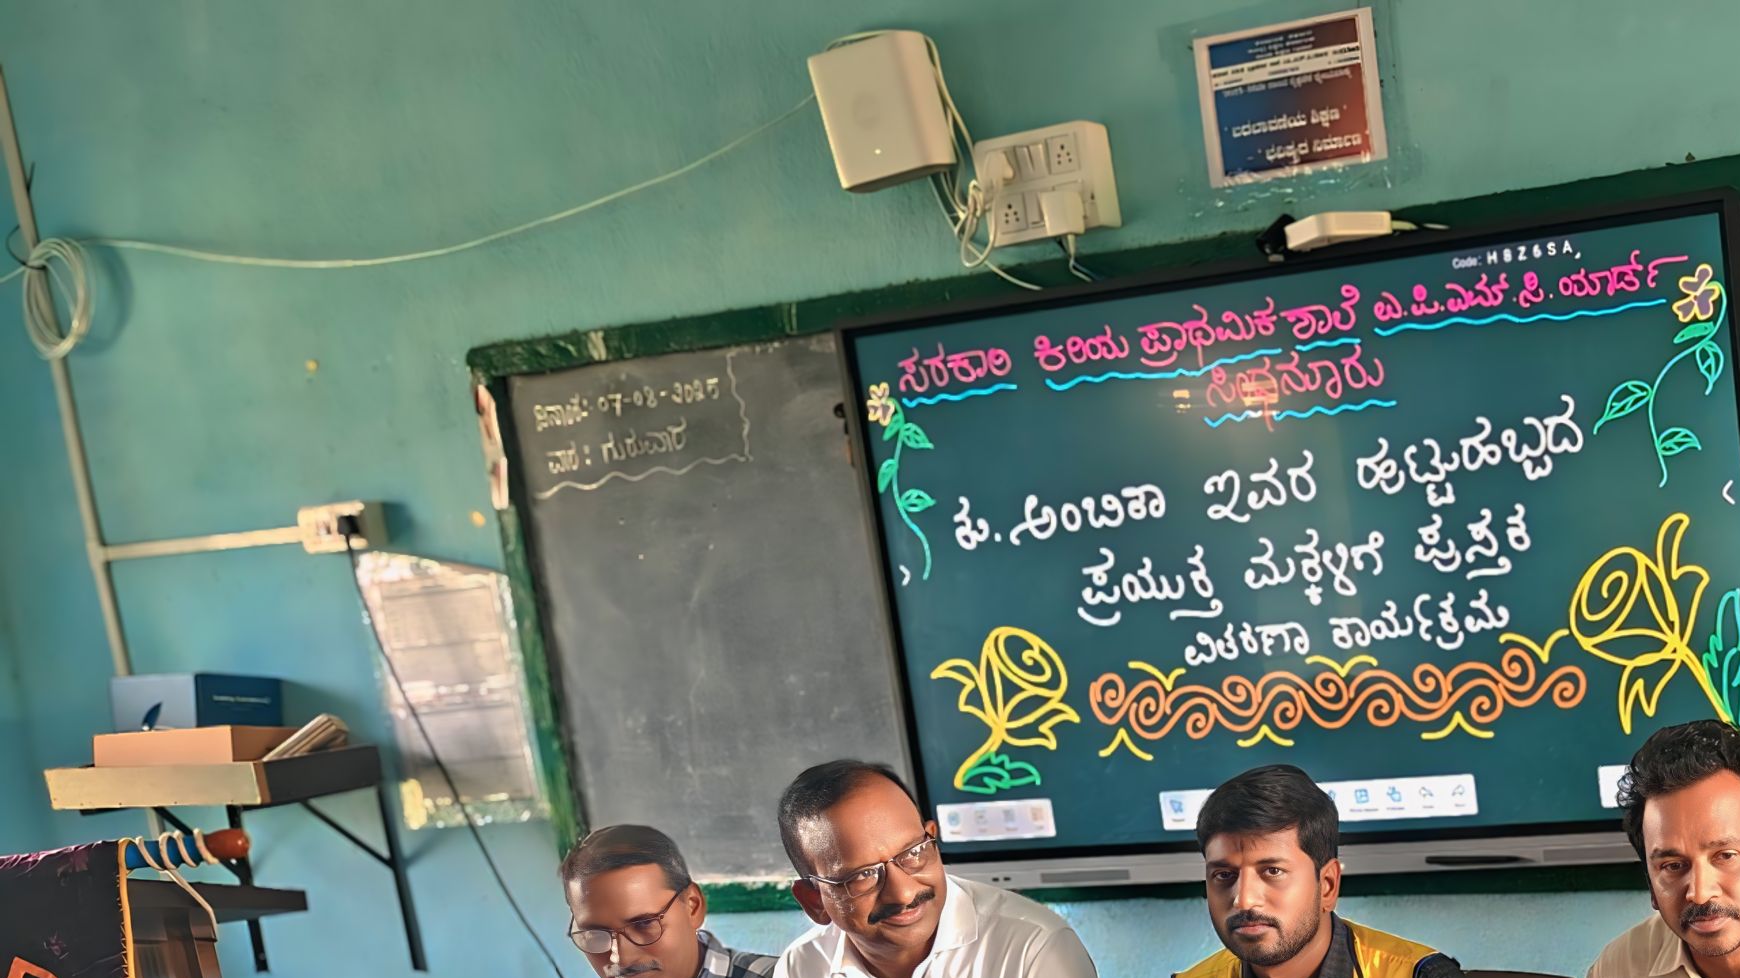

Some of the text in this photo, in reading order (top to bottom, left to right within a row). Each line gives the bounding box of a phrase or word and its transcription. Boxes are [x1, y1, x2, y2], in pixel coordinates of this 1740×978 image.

[897, 342, 1012, 392] ಸರಕಾರಿ
[1033, 324, 1130, 371] ಕಿರಿಯ
[1137, 297, 1277, 366] ಪ್ರಾಥಮಿಕ
[1280, 283, 1360, 340] ಶಾಲೆ
[1009, 483, 1166, 547] ಅಂಬಿಕಾ
[1203, 449, 1317, 524] ಇವರ
[1356, 394, 1585, 508] ಹುಟ್ಟುಹಬ್ಬದ
[1076, 502, 1533, 628] ಪ್ರಯುಕ್ತ ಮಕ್ಕಳಿಗೆ ಪುಸ್ತಕ
[1328, 588, 1511, 650] ಕಾರ್ಯಕ್ರಮ
